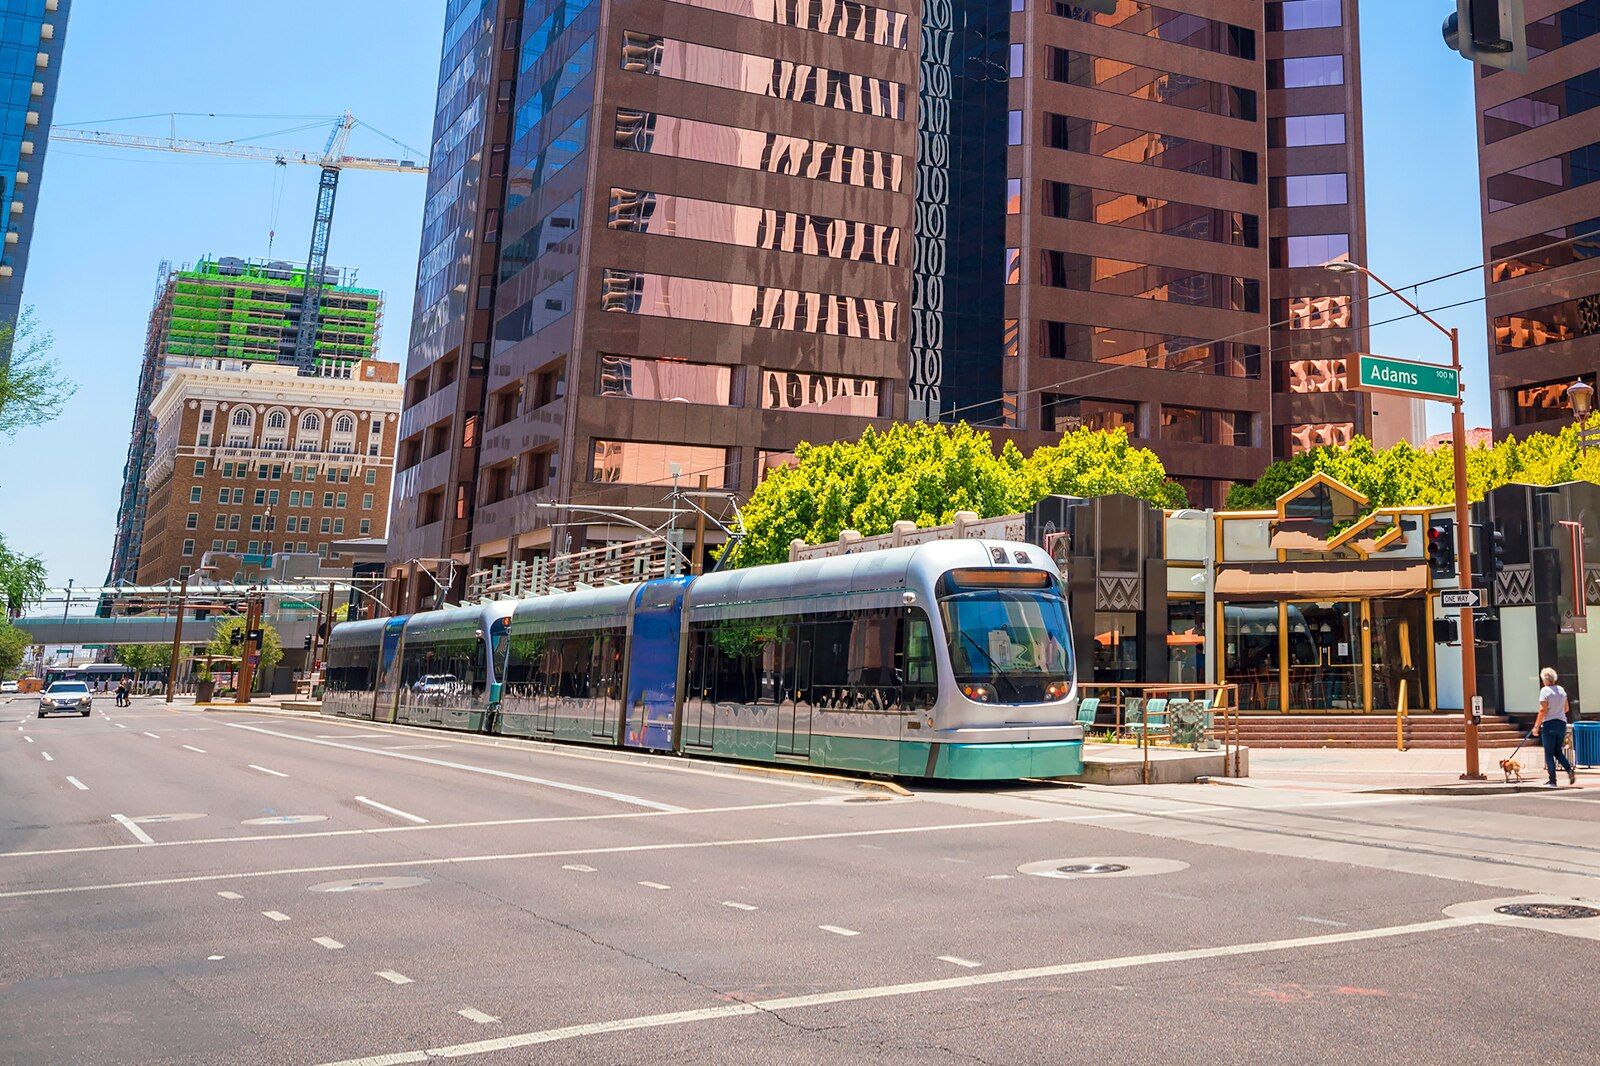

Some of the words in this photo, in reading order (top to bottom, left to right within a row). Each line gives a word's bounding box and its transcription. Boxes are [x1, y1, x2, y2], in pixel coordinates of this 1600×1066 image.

[1371, 365, 1418, 385] Adams
[1436, 370, 1448, 379] 100
[1448, 372, 1454, 380] N
[1444, 595, 1456, 603] ONE
